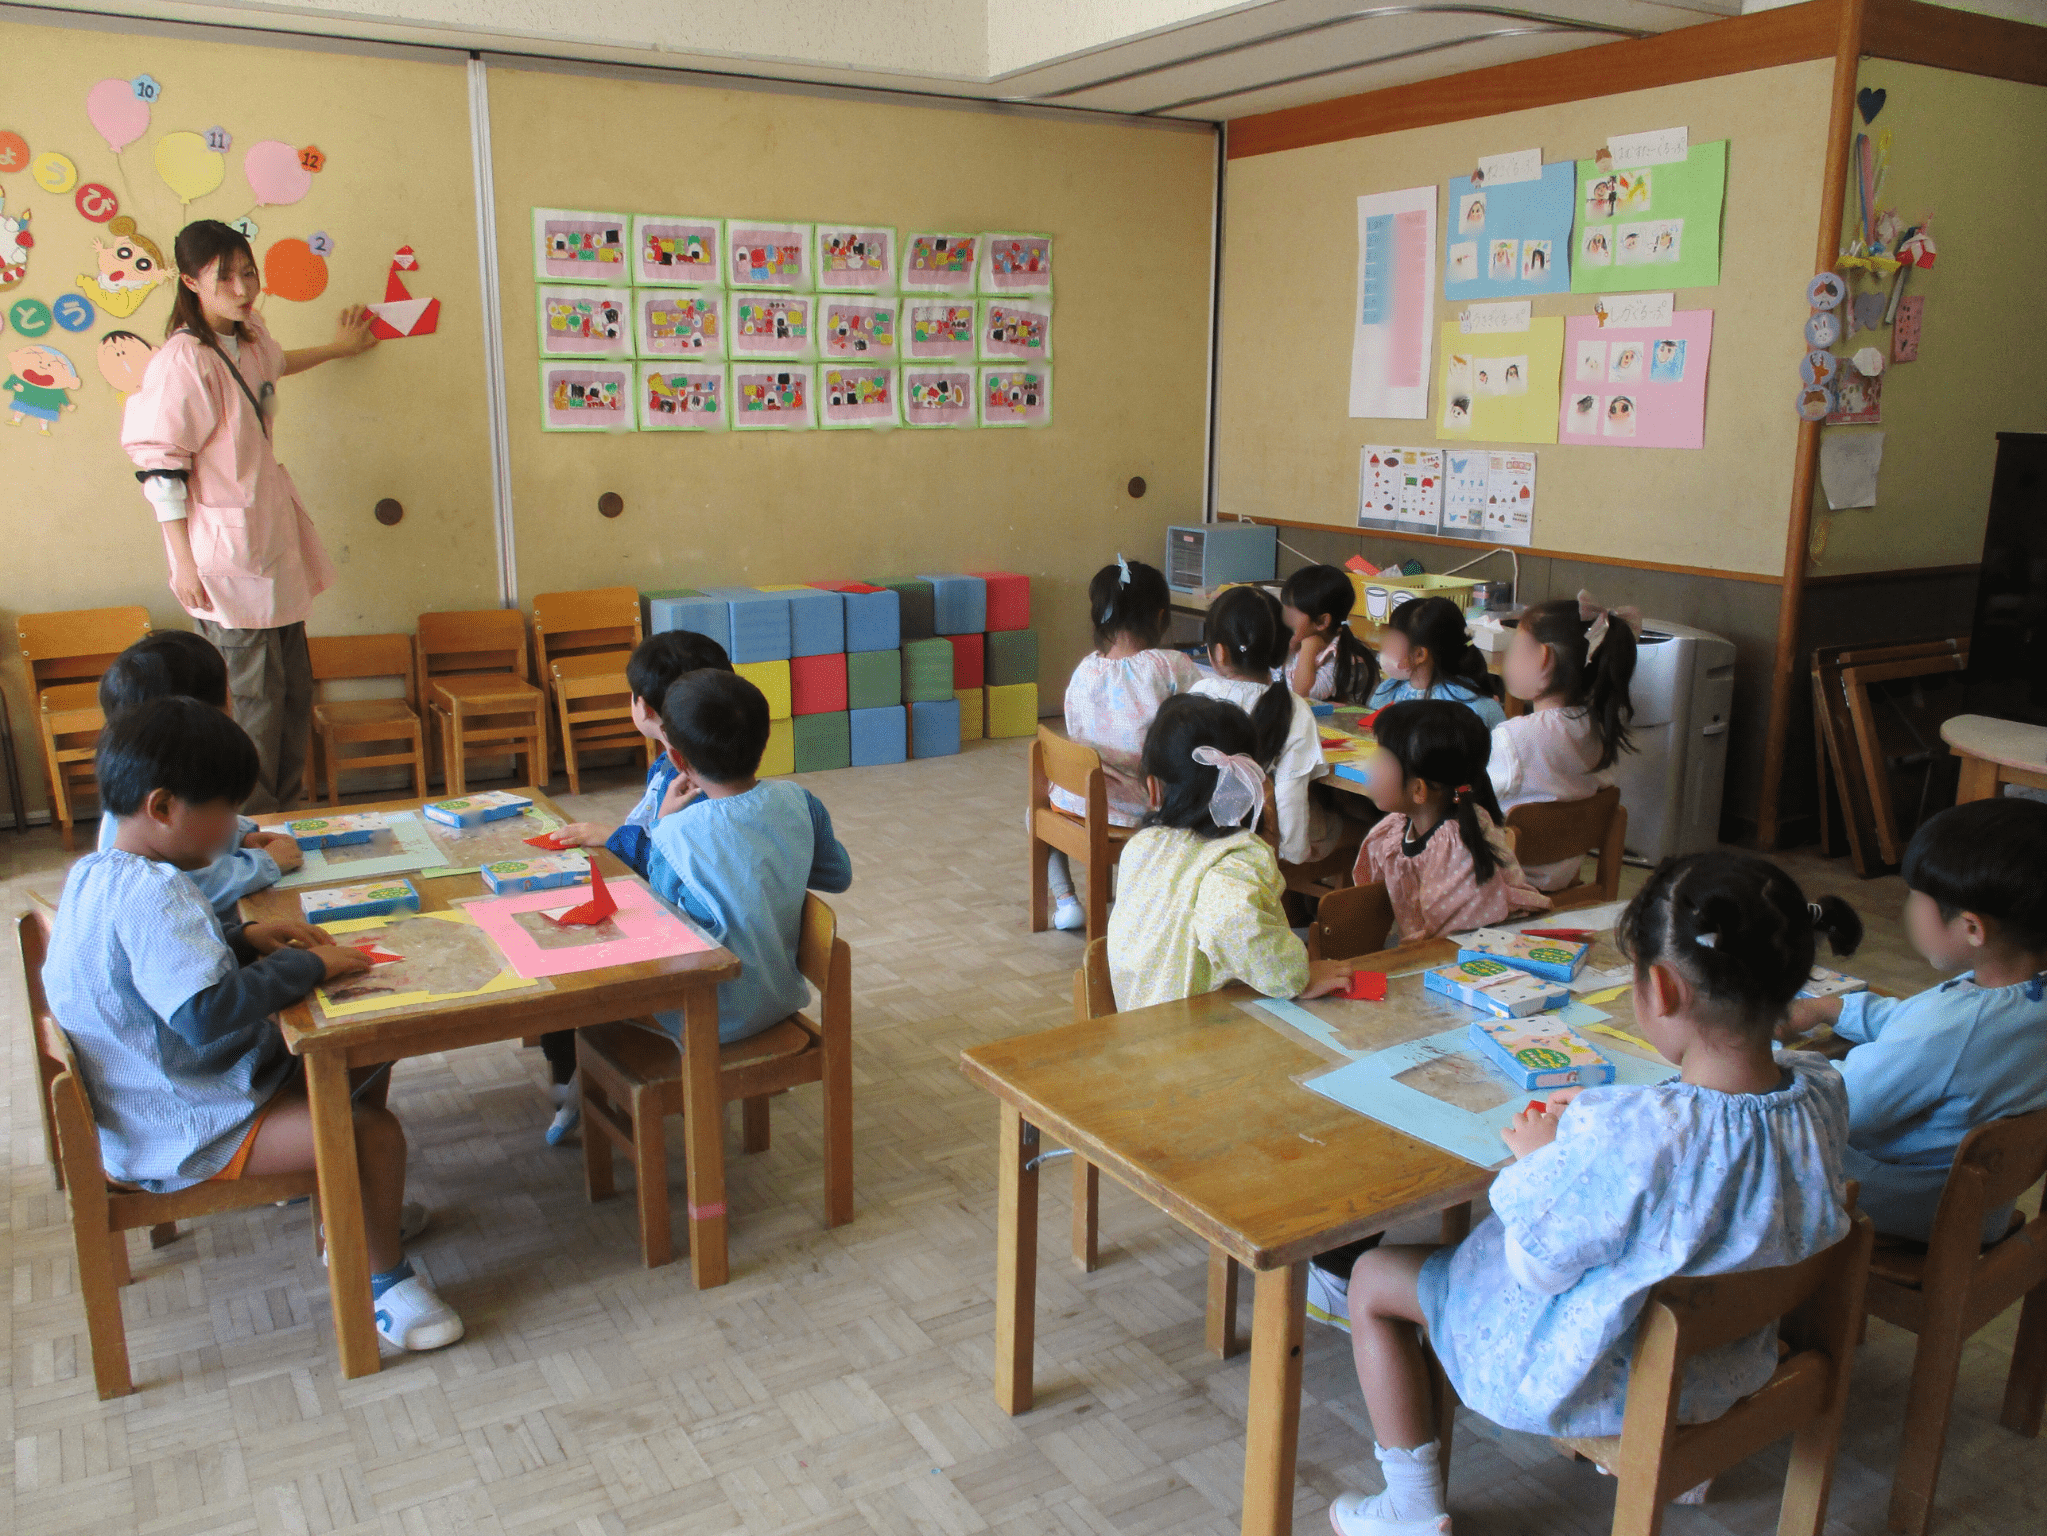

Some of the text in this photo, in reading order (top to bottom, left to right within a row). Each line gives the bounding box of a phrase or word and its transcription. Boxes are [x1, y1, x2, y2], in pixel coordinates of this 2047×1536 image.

[138, 82, 154, 99] 10
[209, 133, 226, 149] 11
[301, 152, 319, 169] 12
[239, 222, 251, 239] 1
[315, 237, 327, 252] 2
